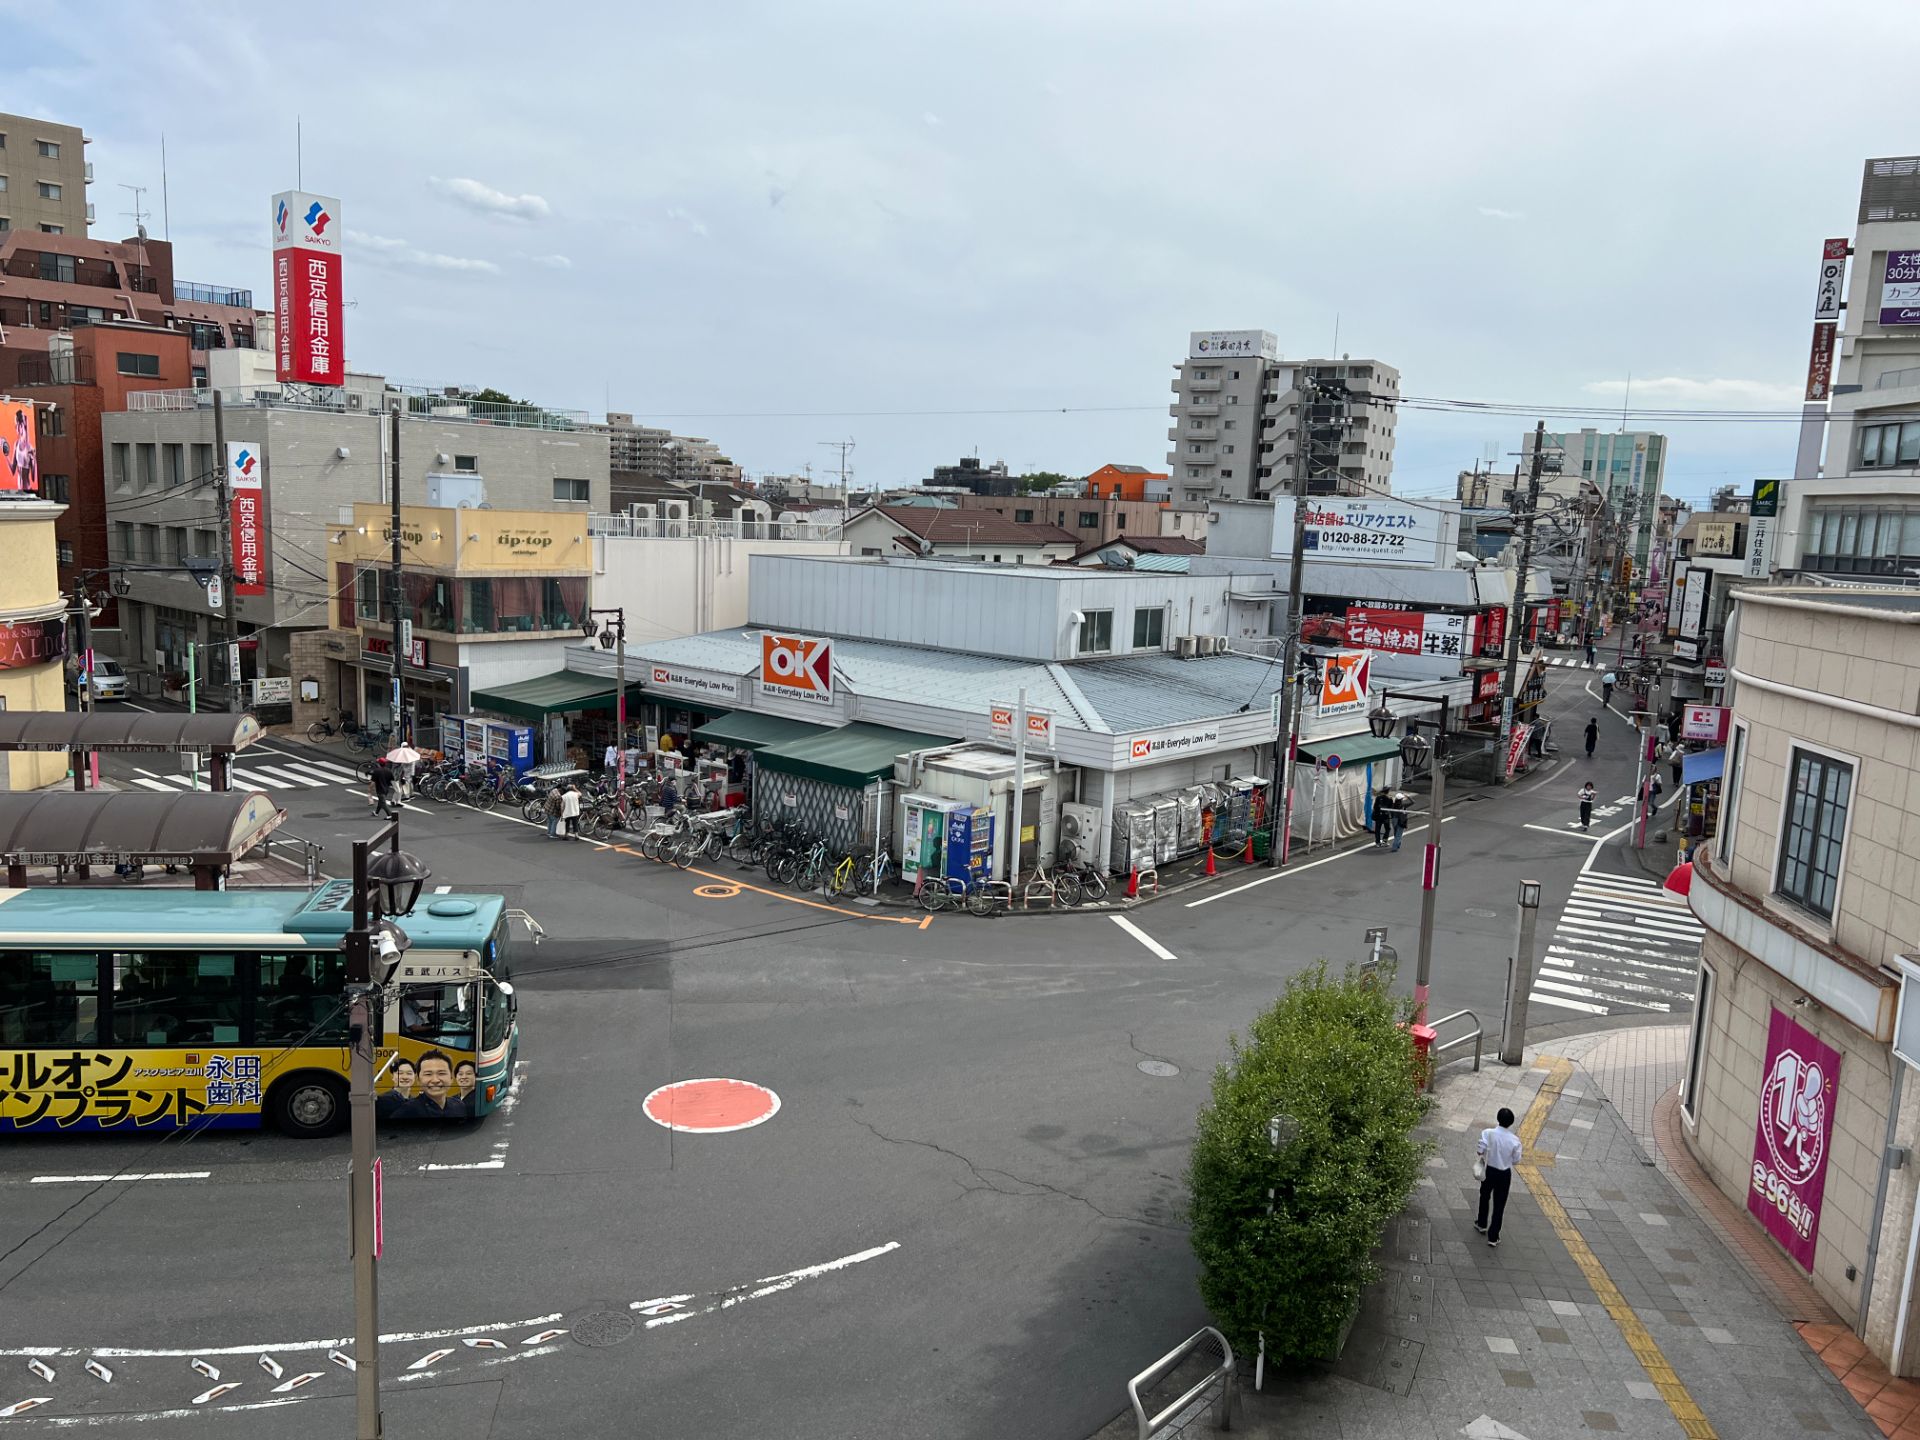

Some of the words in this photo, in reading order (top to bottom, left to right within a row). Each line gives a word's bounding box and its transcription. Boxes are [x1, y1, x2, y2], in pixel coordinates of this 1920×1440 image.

[304, 235, 331, 246] SAIKYO
[1818, 265, 1838, 313] 日高屋
[278, 257, 291, 372] 西京信用金庫
[307, 258, 330, 375] 西京信用金庫
[239, 498, 257, 586] 西京信用金庫
[1322, 531, 1405, 546] 0120-88-27-22
[1751, 519, 1767, 576] 三井住友銀行
[1447, 617, 1463, 627] 2F
[367, 637, 393, 655] KFC
[1347, 626, 1420, 650] 七輪焼肉
[1424, 632, 1460, 655] 牛繁
[769, 637, 831, 692] OK
[655, 669, 670, 683] OK
[708, 680, 721, 690] Low
[721, 682, 735, 692] Price
[803, 689, 815, 700] Low
[816, 692, 830, 703] Price
[994, 712, 1012, 725] OK
[1030, 718, 1048, 731] OK
[1135, 740, 1150, 756] OK
[1192, 735, 1204, 744] Low
[1204, 732, 1217, 742] Price
[4, 853, 59, 866] 下里団地
[404, 967, 461, 976] 西武バス
[0, 1052, 134, 1090] ルオン
[205, 1055, 260, 1080] 永田
[205, 1080, 262, 1106] 歯科
[0, 1086, 207, 1128] ンプラント
[1752, 1158, 1815, 1241] 全96台!!
